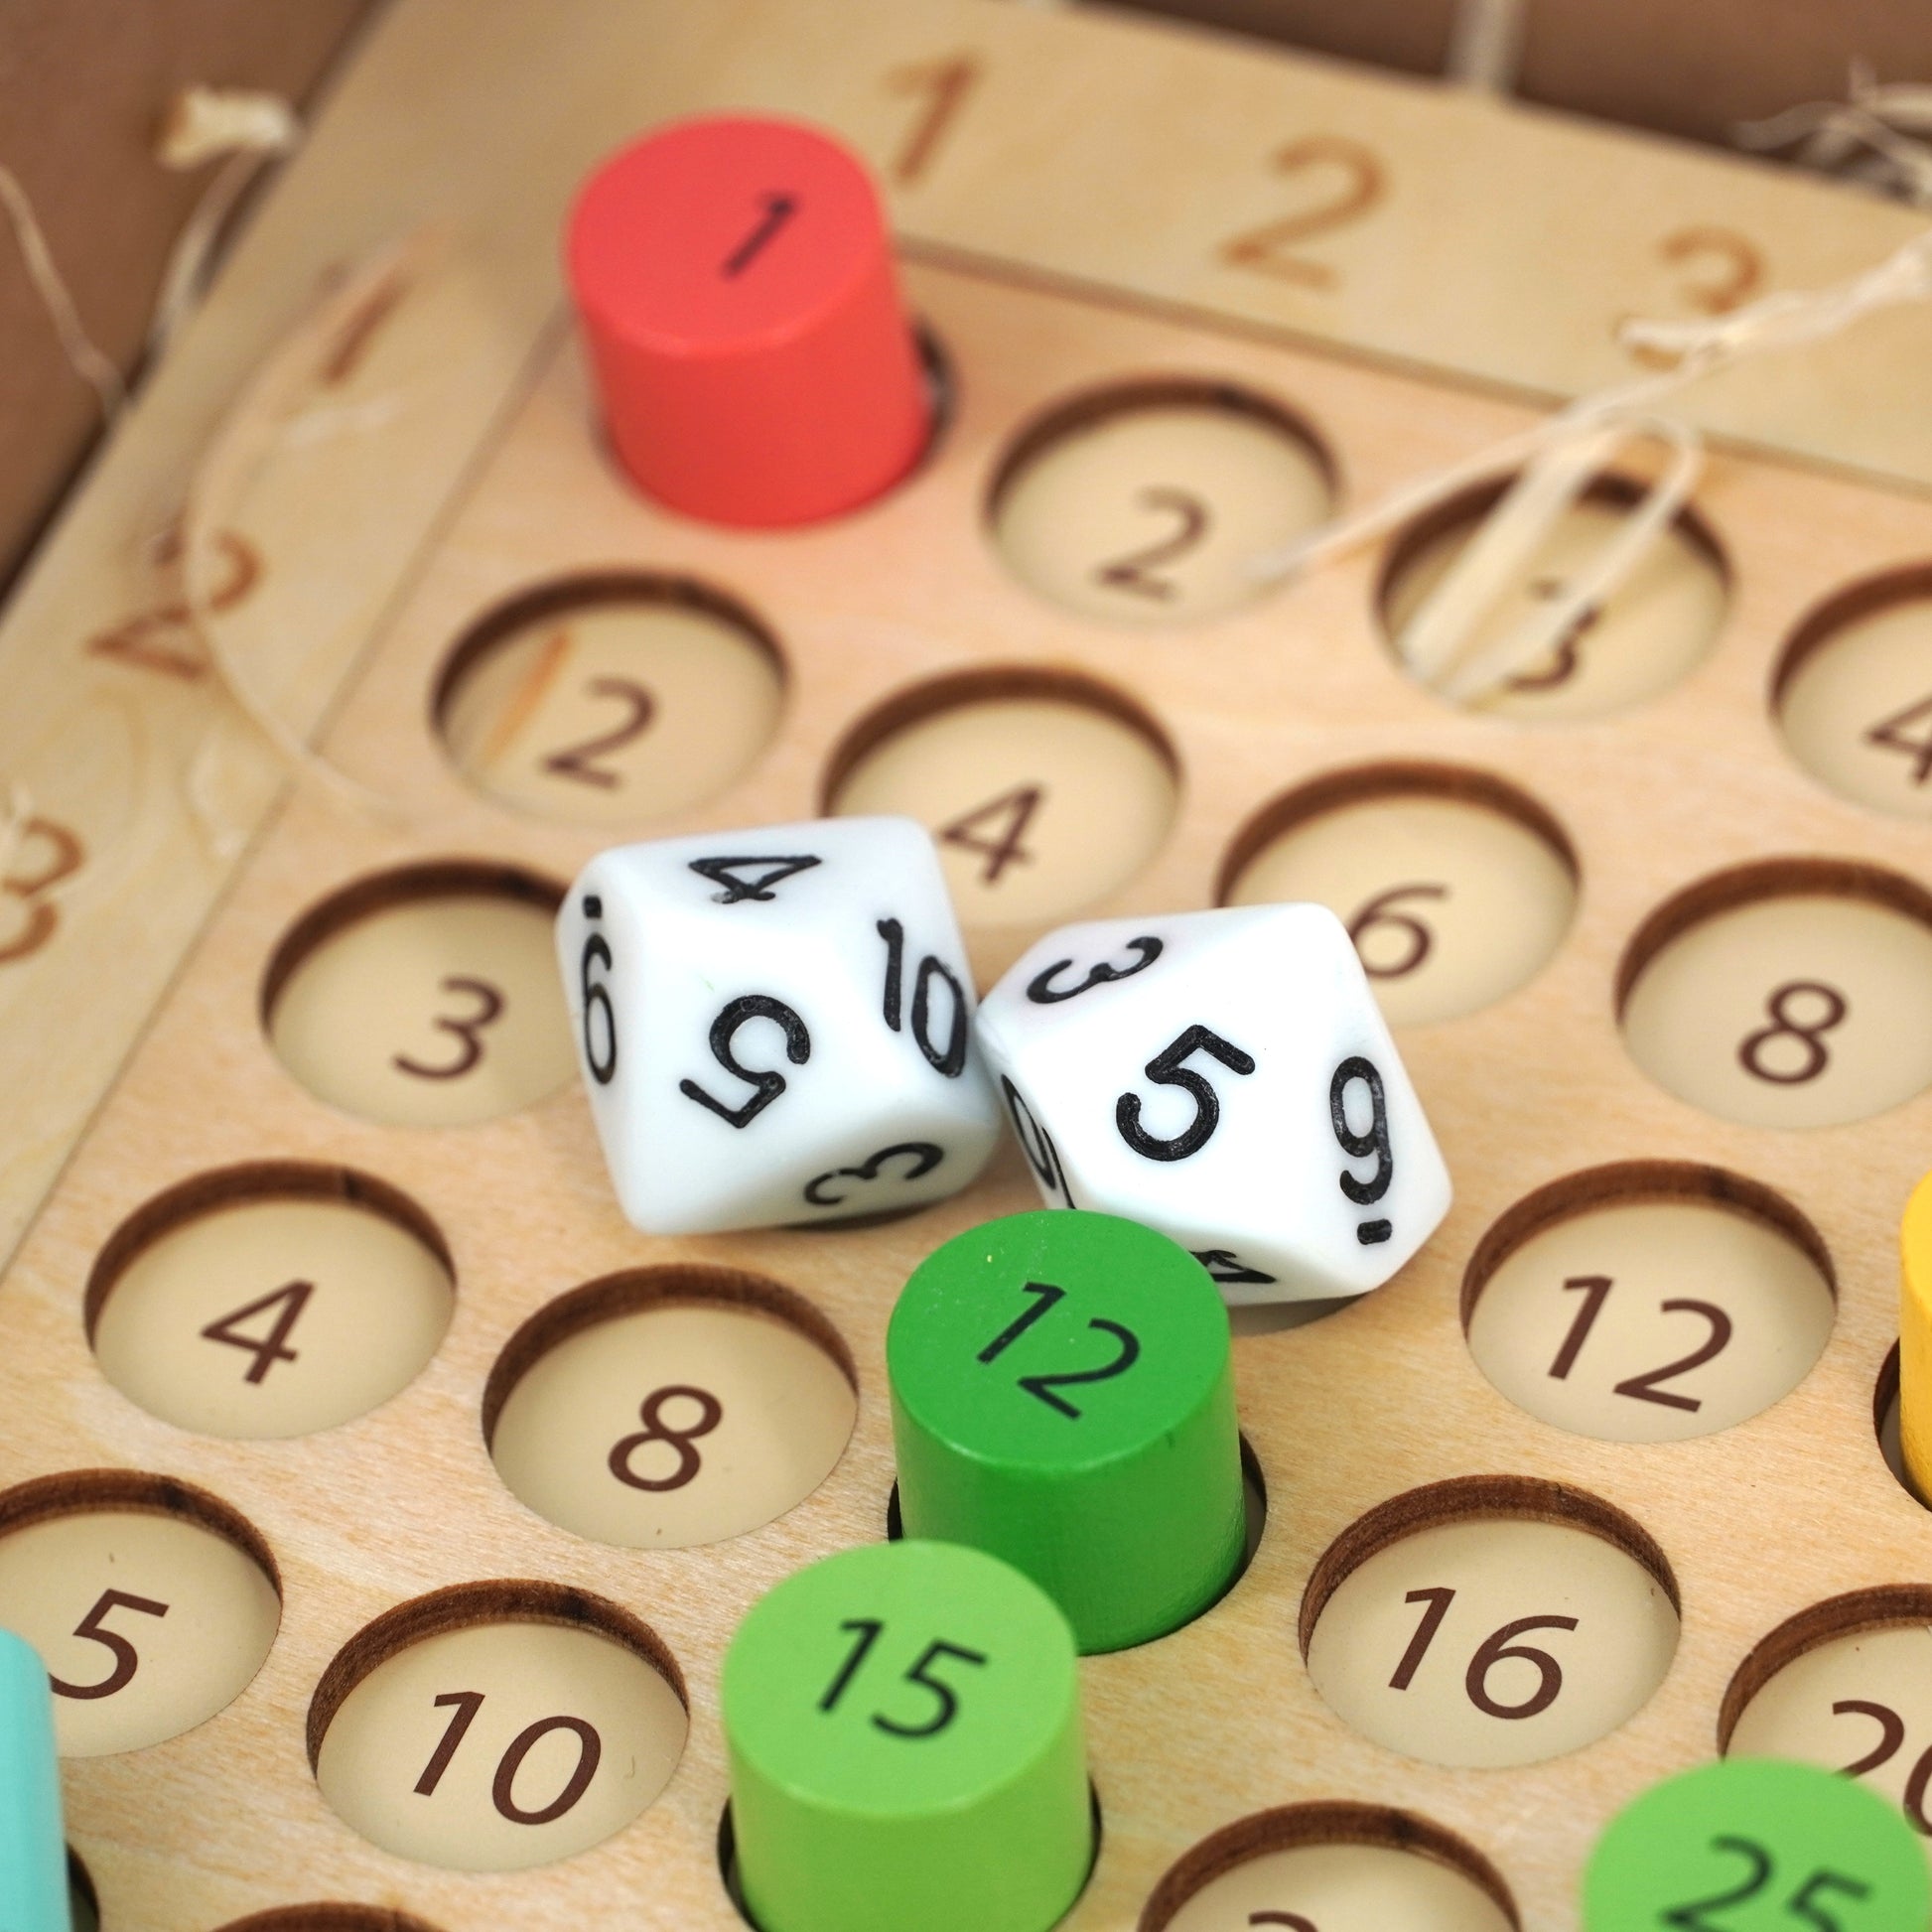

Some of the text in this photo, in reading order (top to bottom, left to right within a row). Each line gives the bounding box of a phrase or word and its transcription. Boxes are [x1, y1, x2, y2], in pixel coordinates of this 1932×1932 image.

[876, 50, 988, 191] 1
[719, 191, 800, 281] 1
[1217, 132, 1392, 292] 2
[1095, 486, 1211, 602] 2
[541, 677, 659, 791] 2
[688, 854, 823, 905] 4
[941, 782, 1044, 887] 4
[1027, 936, 1164, 1004] 3
[1348, 882, 1451, 981] 6
[391, 973, 506, 1080] 3
[876, 917, 969, 1078] 10
[1735, 977, 1849, 1086] 8
[679, 994, 811, 1130] 5
[1115, 1024, 1256, 1163] 5
[803, 1142, 945, 1205] 3
[200, 1279, 315, 1385] 4
[975, 1281, 1142, 1420] 12
[1547, 1275, 1733, 1414] 12
[607, 1384, 724, 1493] 8
[48, 1587, 170, 1701] 5
[814, 1615, 988, 1742] 15
[1388, 1587, 1581, 1721] 16
[412, 1691, 603, 1826] 10
